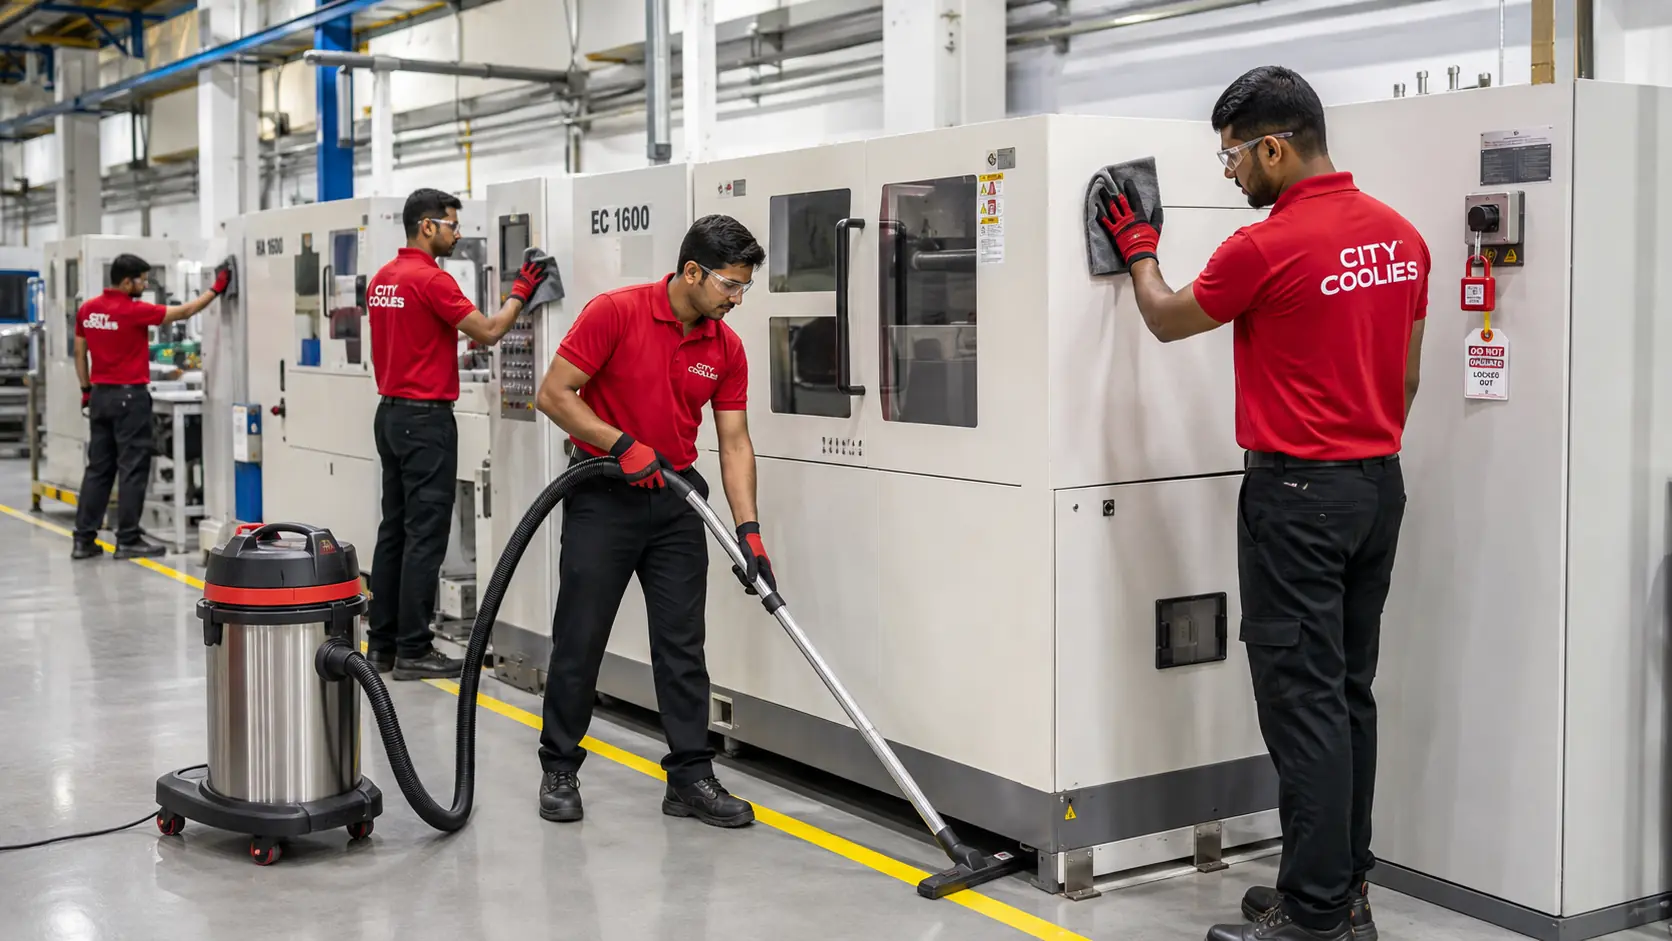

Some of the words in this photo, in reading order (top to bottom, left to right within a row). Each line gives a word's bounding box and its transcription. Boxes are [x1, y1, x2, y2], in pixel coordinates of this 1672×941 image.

[591, 208, 609, 234] EC
[614, 205, 650, 233] 1600
[1339, 240, 1398, 268] CITY
[1320, 261, 1418, 296] COOLIES
[375, 284, 399, 296] CITY
[1485, 347, 1503, 357] NOT
[1479, 379, 1494, 387] OUT
